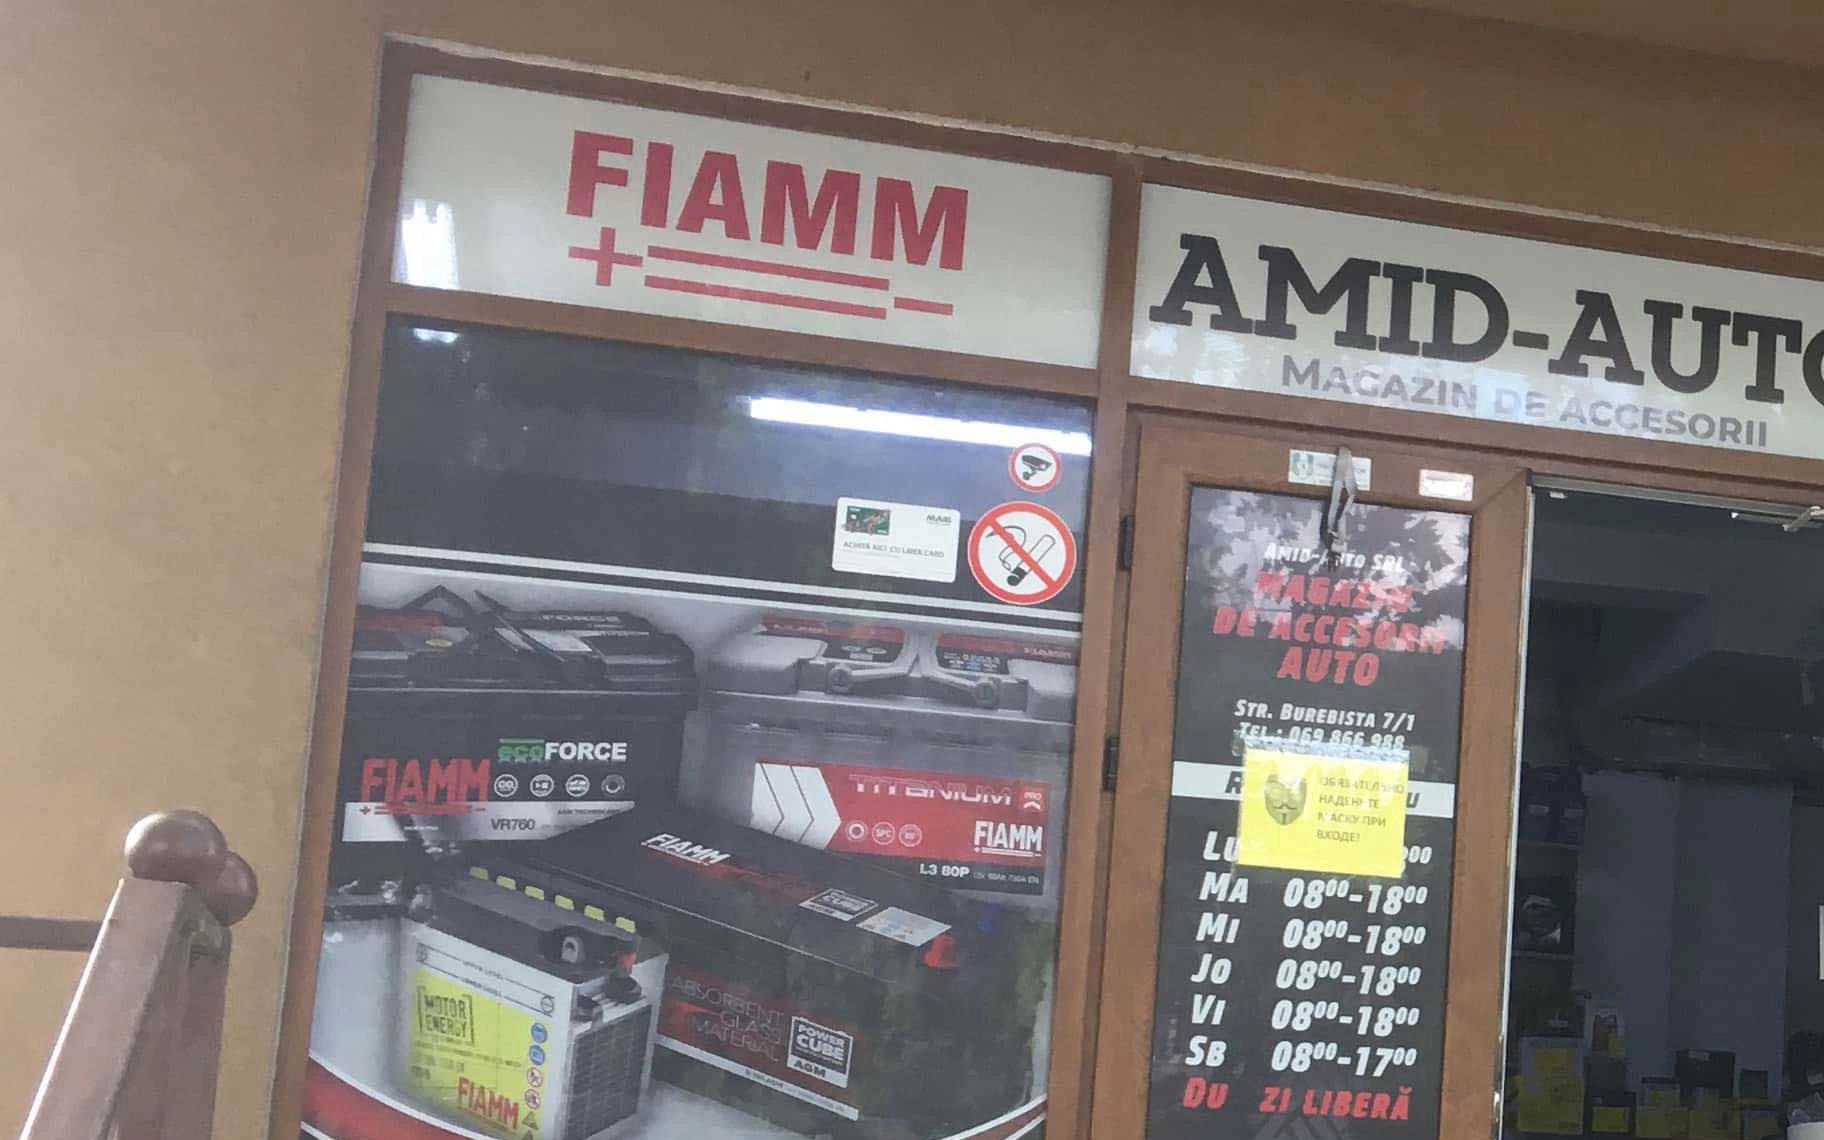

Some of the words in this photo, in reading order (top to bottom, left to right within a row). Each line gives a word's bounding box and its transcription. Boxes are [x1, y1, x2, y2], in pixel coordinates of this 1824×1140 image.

[566, 130, 968, 270] FIAMM
[1282, 355, 1477, 411] MAGAZIN
[1494, 387, 1546, 417] DE
[1560, 395, 1767, 447] ACCESORII
[1255, 571, 1414, 613] MAGAZIN
[1213, 607, 1257, 637] DE
[1276, 647, 1380, 686] AUTO
[1234, 700, 1273, 719] STR.
[1280, 703, 1376, 728] BUREBISTA
[1382, 712, 1415, 731] 7/1
[361, 758, 491, 803] FIAMM
[1319, 794, 1380, 809] НАДЕНТЕ
[490, 818, 536, 831] VR760
[974, 820, 1043, 851] FIAMM
[1362, 815, 1387, 828] ПРИ
[647, 833, 731, 865] FIAMM
[920, 863, 937, 876] L3
[1199, 871, 1249, 904] MA
[1196, 912, 1240, 944] MI
[1191, 953, 1232, 984] JO
[424, 994, 467, 1021] MOTOR
[670, 976, 784, 1025] ABSORBENT
[1191, 994, 1226, 1025] VI
[425, 1014, 468, 1038] ENERGY
[694, 1016, 780, 1062] MATERIAL
[720, 1010, 782, 1044] GLASS
[798, 1023, 845, 1048] POWER
[797, 1034, 845, 1061] CUBE
[1185, 1035, 1227, 1067] SB
[794, 1060, 826, 1077] AGM
[458, 1076, 520, 1130] FIAMM
[1182, 1077, 1229, 1110] DU
[1259, 1087, 1291, 1113] ZI
[1303, 1087, 1413, 1121] LIBERĂ
